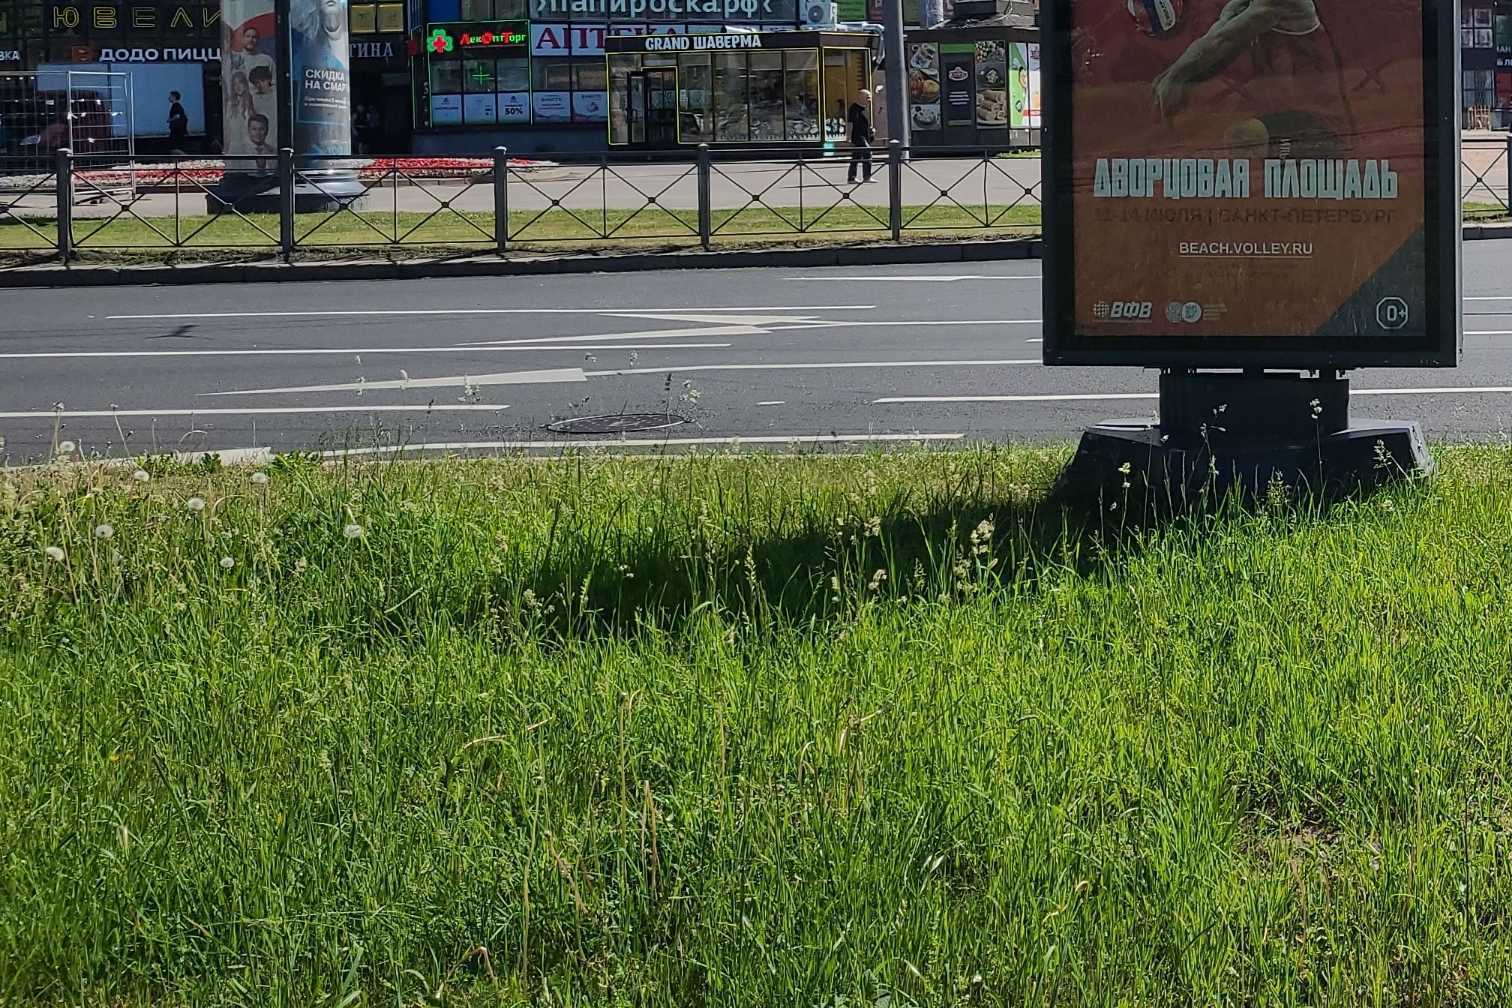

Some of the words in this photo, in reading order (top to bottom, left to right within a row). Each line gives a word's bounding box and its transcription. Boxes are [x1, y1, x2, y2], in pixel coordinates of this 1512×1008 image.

[645, 37, 691, 51] GRAND
[693, 34, 763, 49] ШАВЕРМА
[99, 48, 160, 62] ДОДО
[304, 79, 320, 90] НА
[504, 107, 524, 116] 50%
[1093, 158, 1251, 199] ДВОРЦОВАЯ
[1264, 158, 1399, 200] ПЛОЩАДЬ
[1217, 208, 1397, 225] САНКТ-ПЕТЕРБУРГ
[1179, 242, 1313, 255] BEACH.VOLLEY.RU
[1110, 301, 1153, 318] ВФВ
